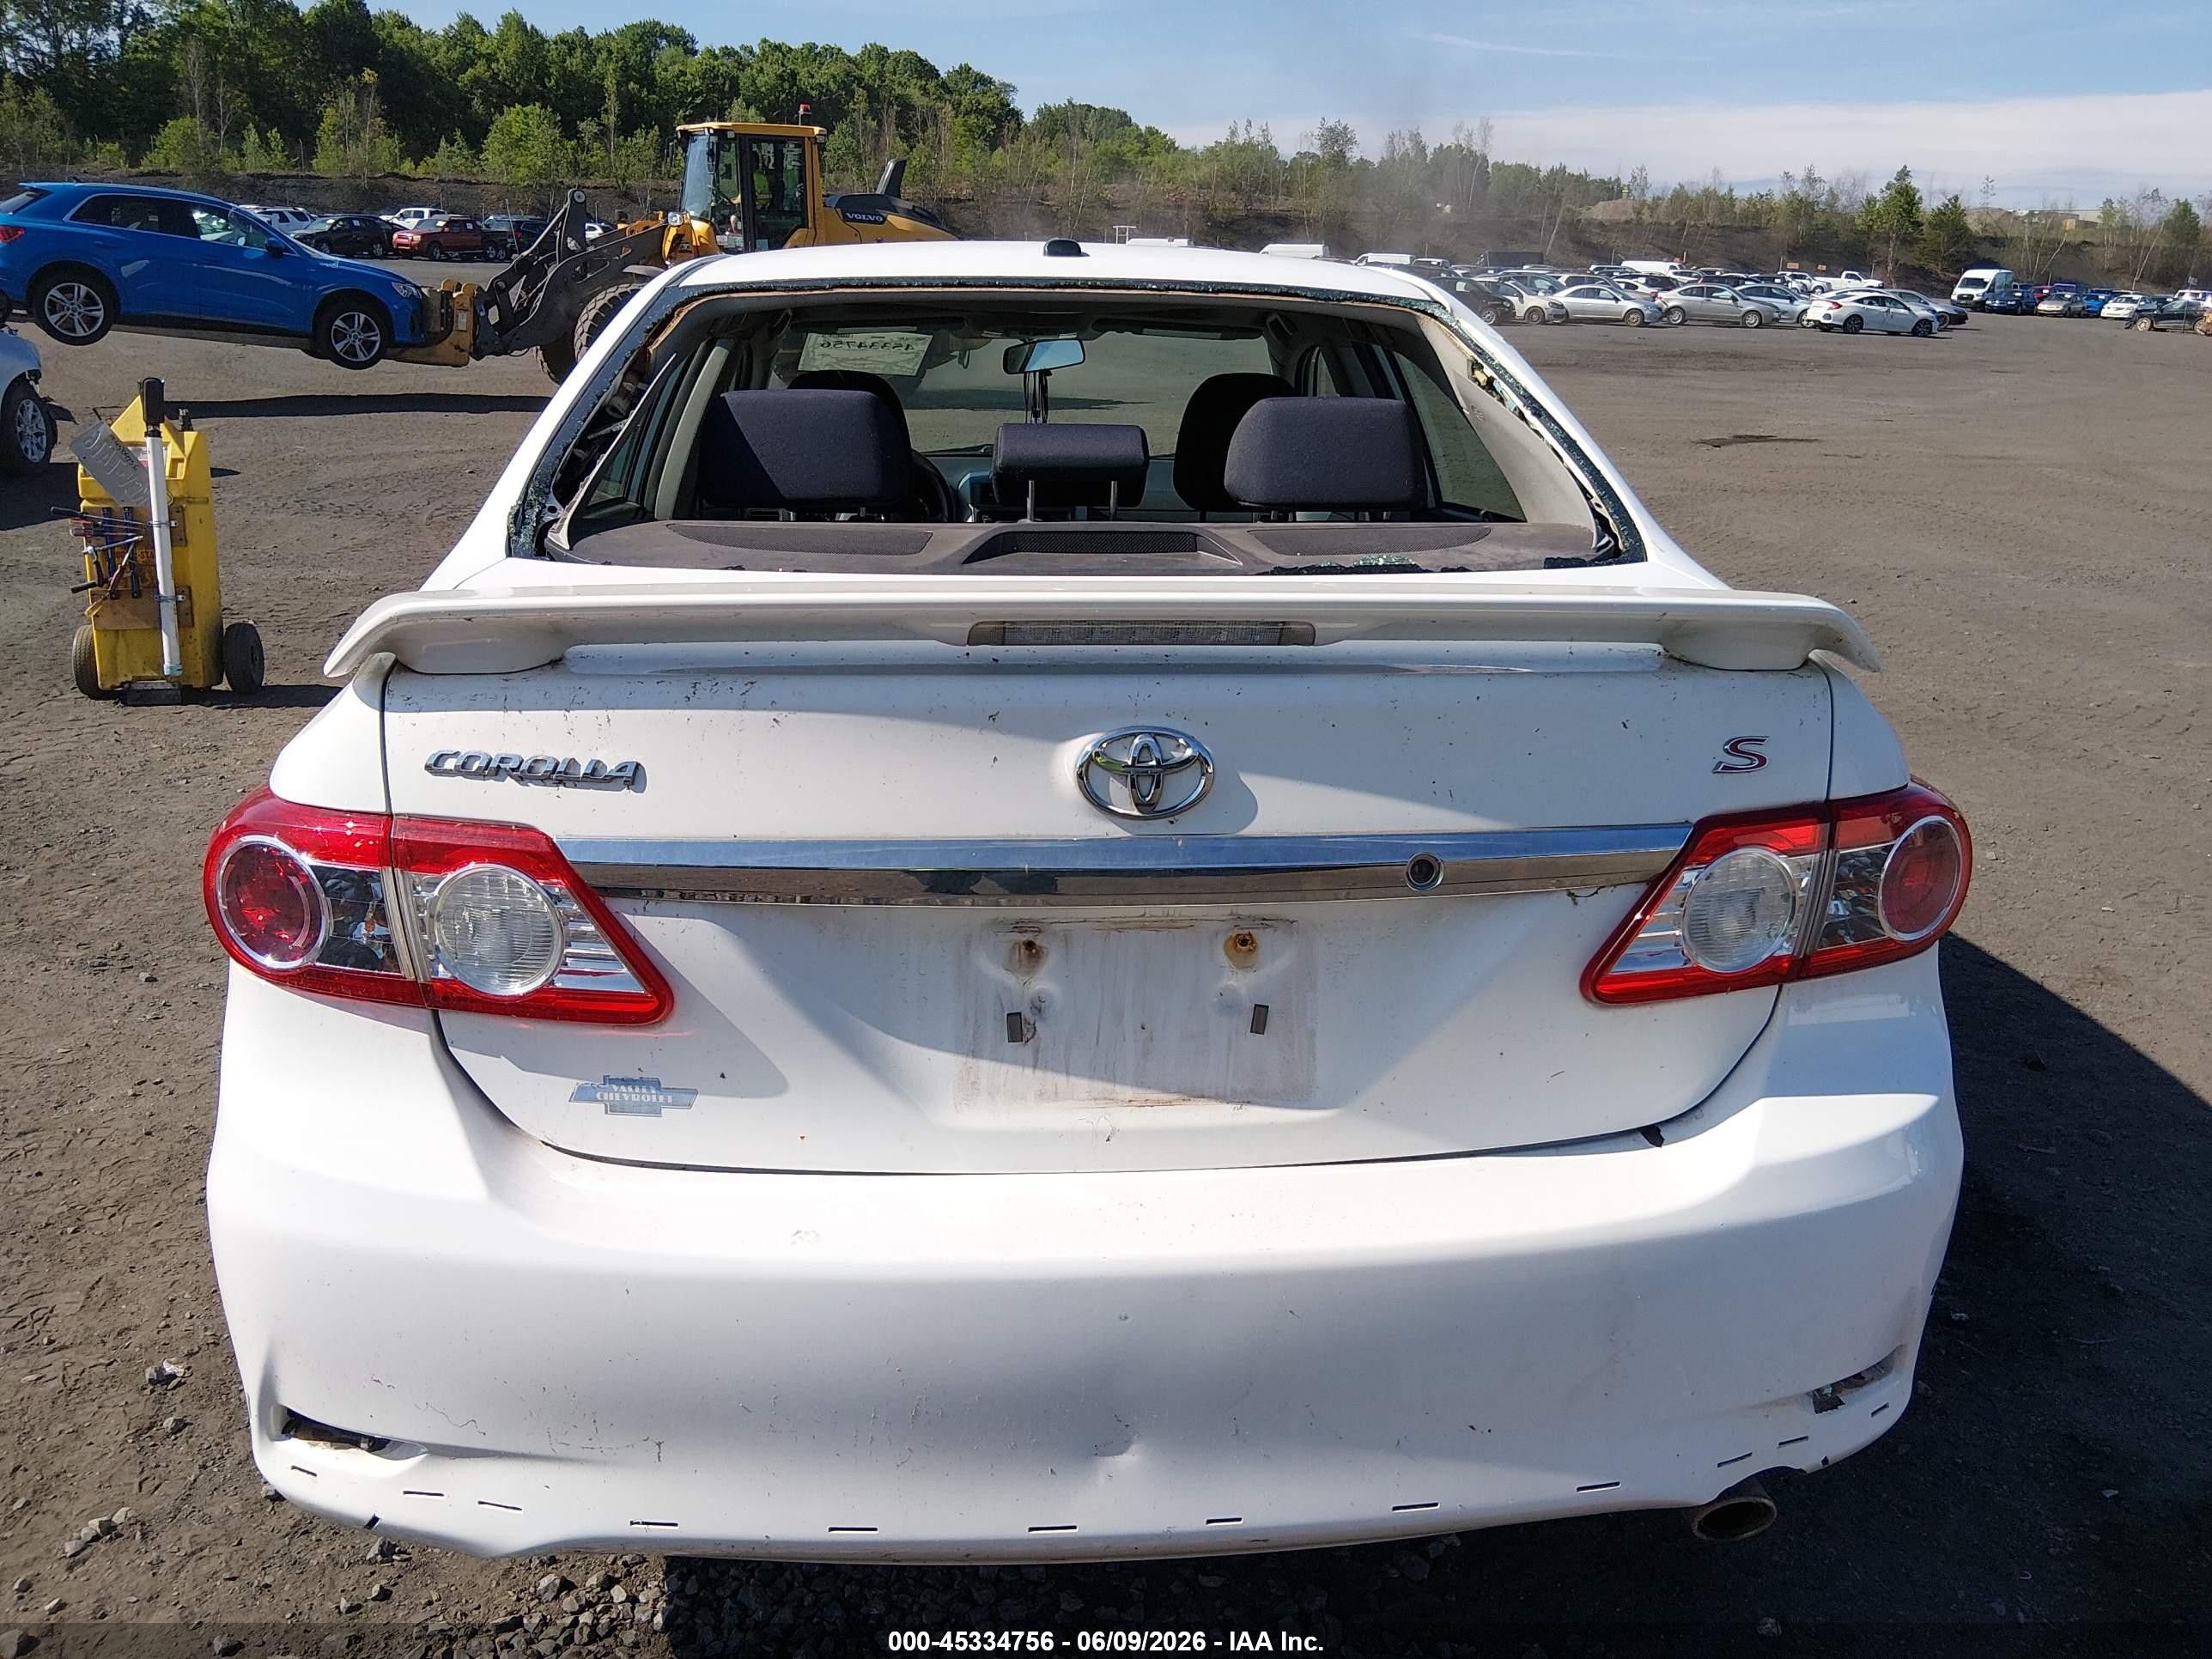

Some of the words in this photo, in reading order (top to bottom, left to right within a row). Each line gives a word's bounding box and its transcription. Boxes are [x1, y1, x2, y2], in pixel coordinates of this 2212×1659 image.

[845, 212, 884, 222] VOLVO
[1711, 735, 1770, 775] S
[424, 749, 641, 788] COROLLA
[595, 1091, 673, 1103] CHEVROLET
